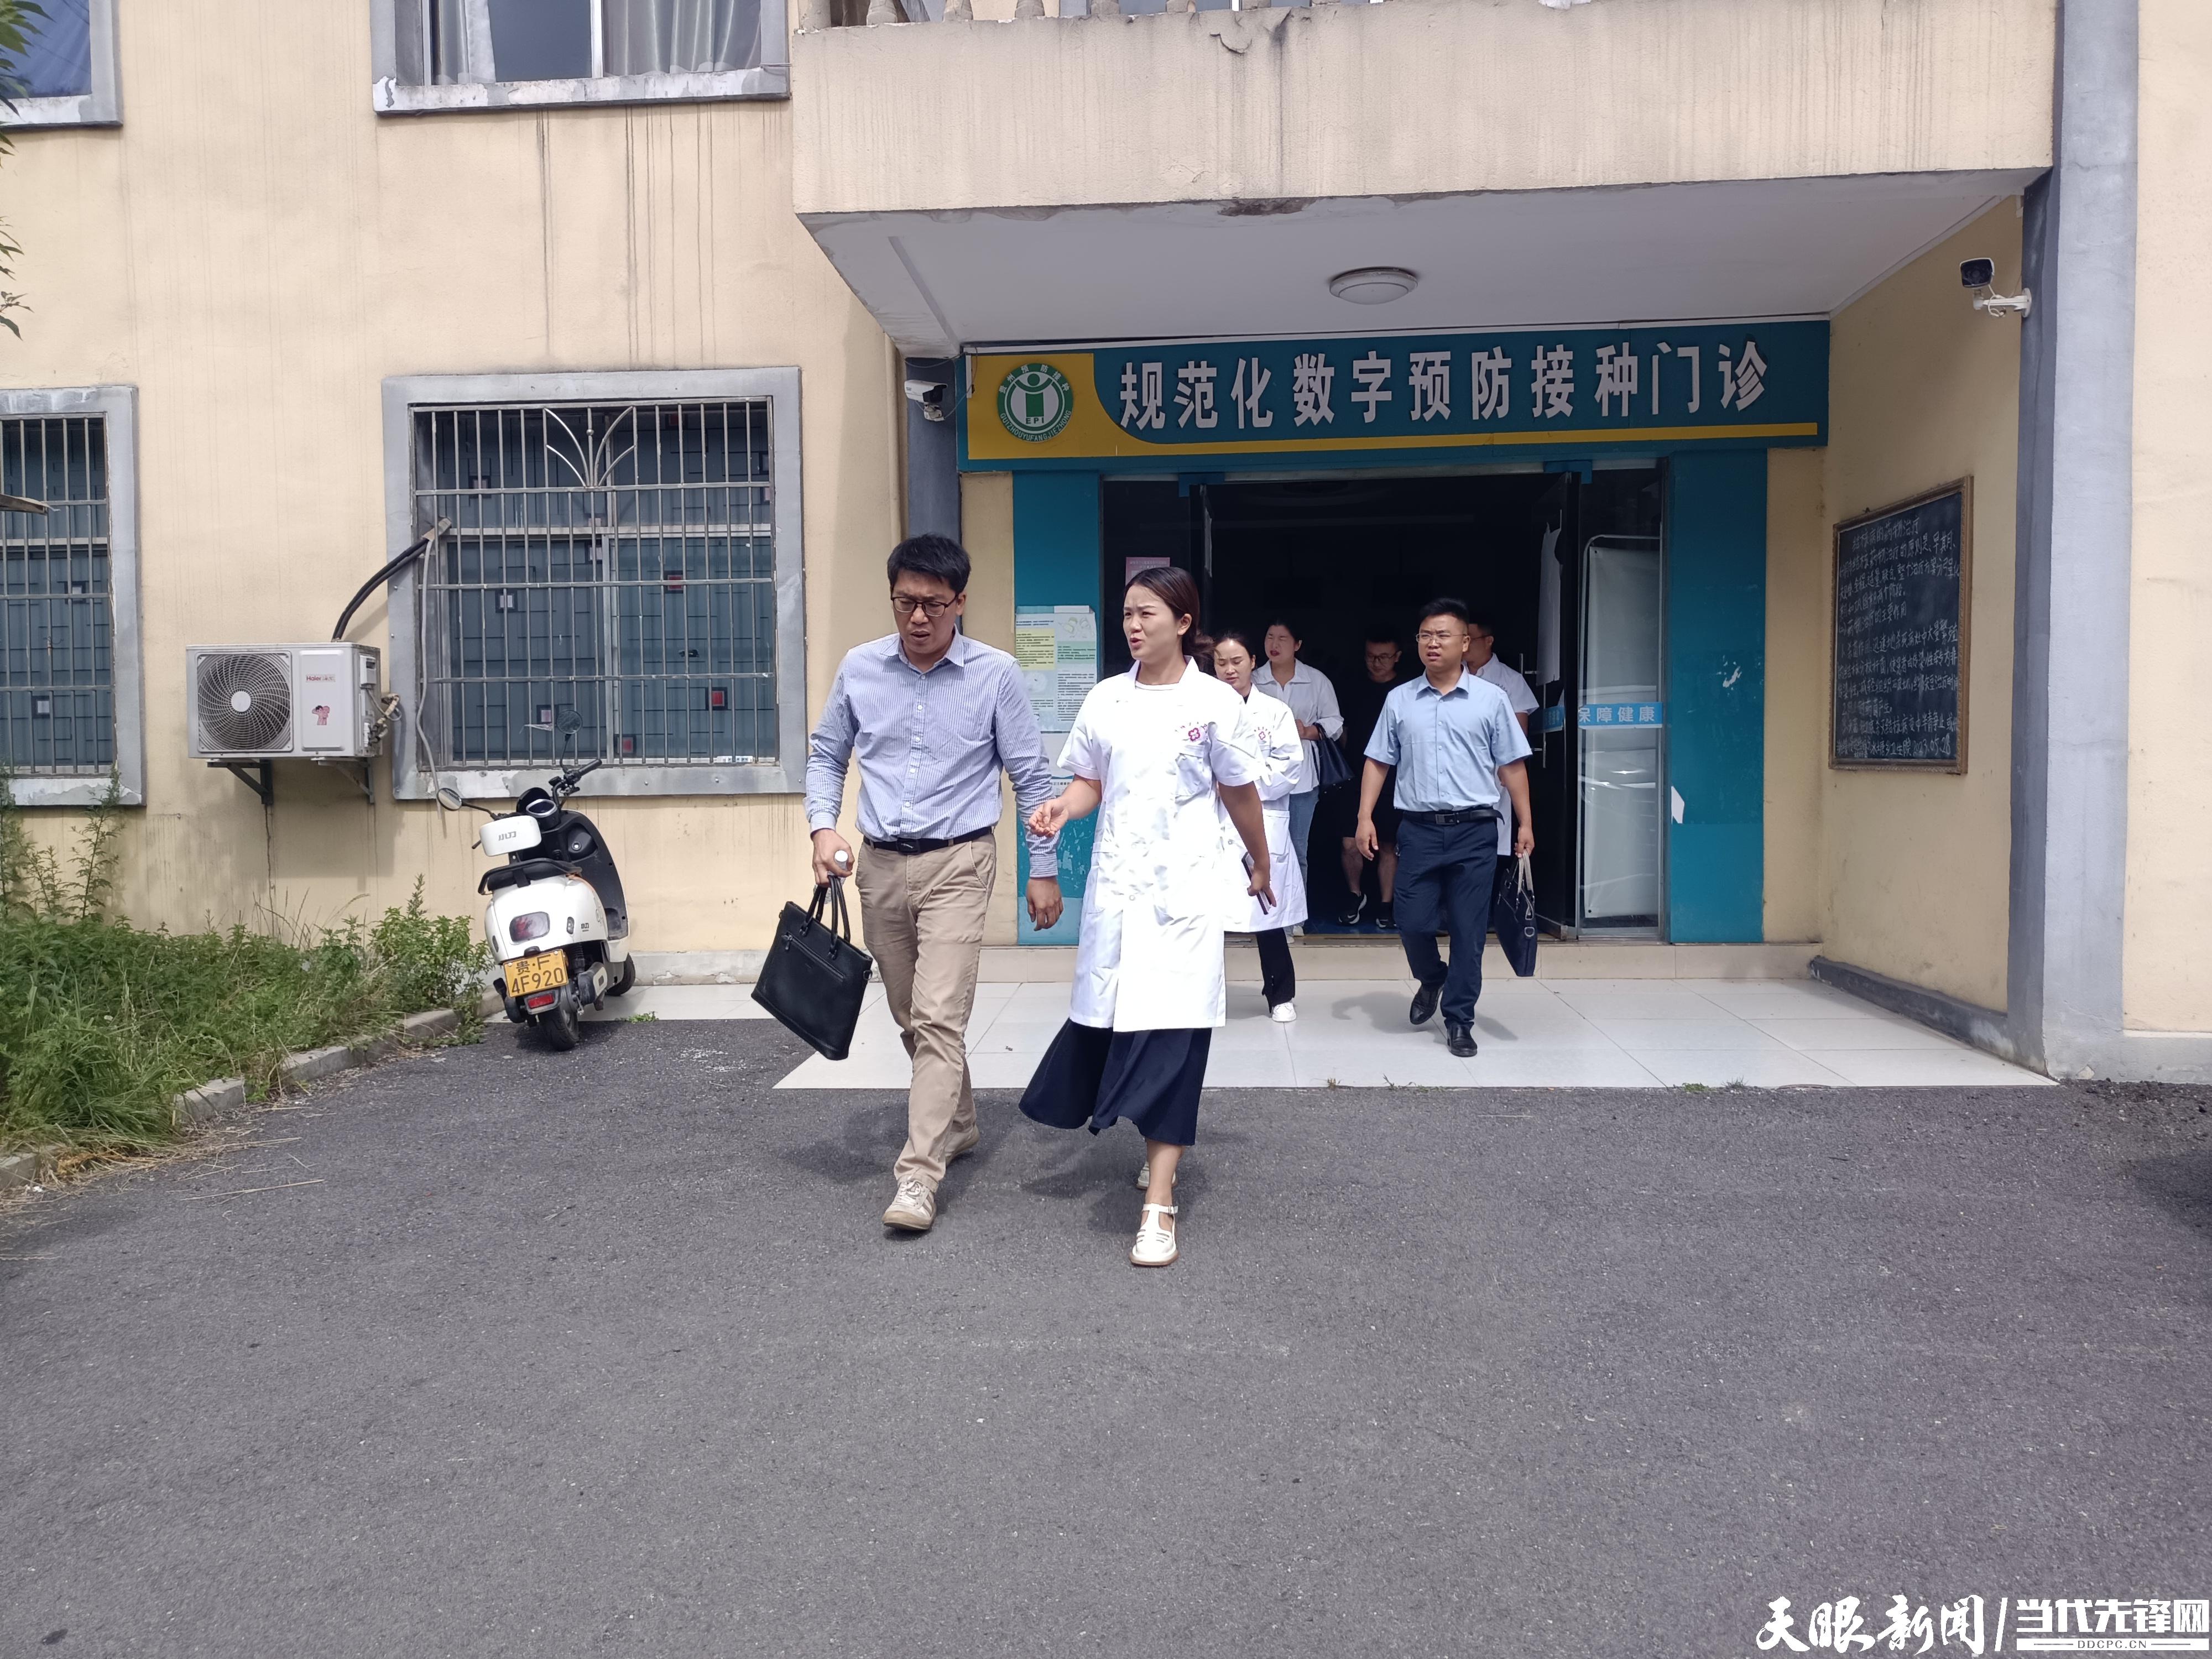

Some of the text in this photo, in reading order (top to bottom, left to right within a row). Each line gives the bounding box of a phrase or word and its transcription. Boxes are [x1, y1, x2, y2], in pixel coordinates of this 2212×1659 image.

[1120, 341, 1767, 429] 规范化数字预防接种门诊
[1000, 410, 1072, 442] GUIZHOUYUFANGJIEZHONG
[516, 954, 550, 974] 贵·F
[512, 970, 564, 994] 4F920
